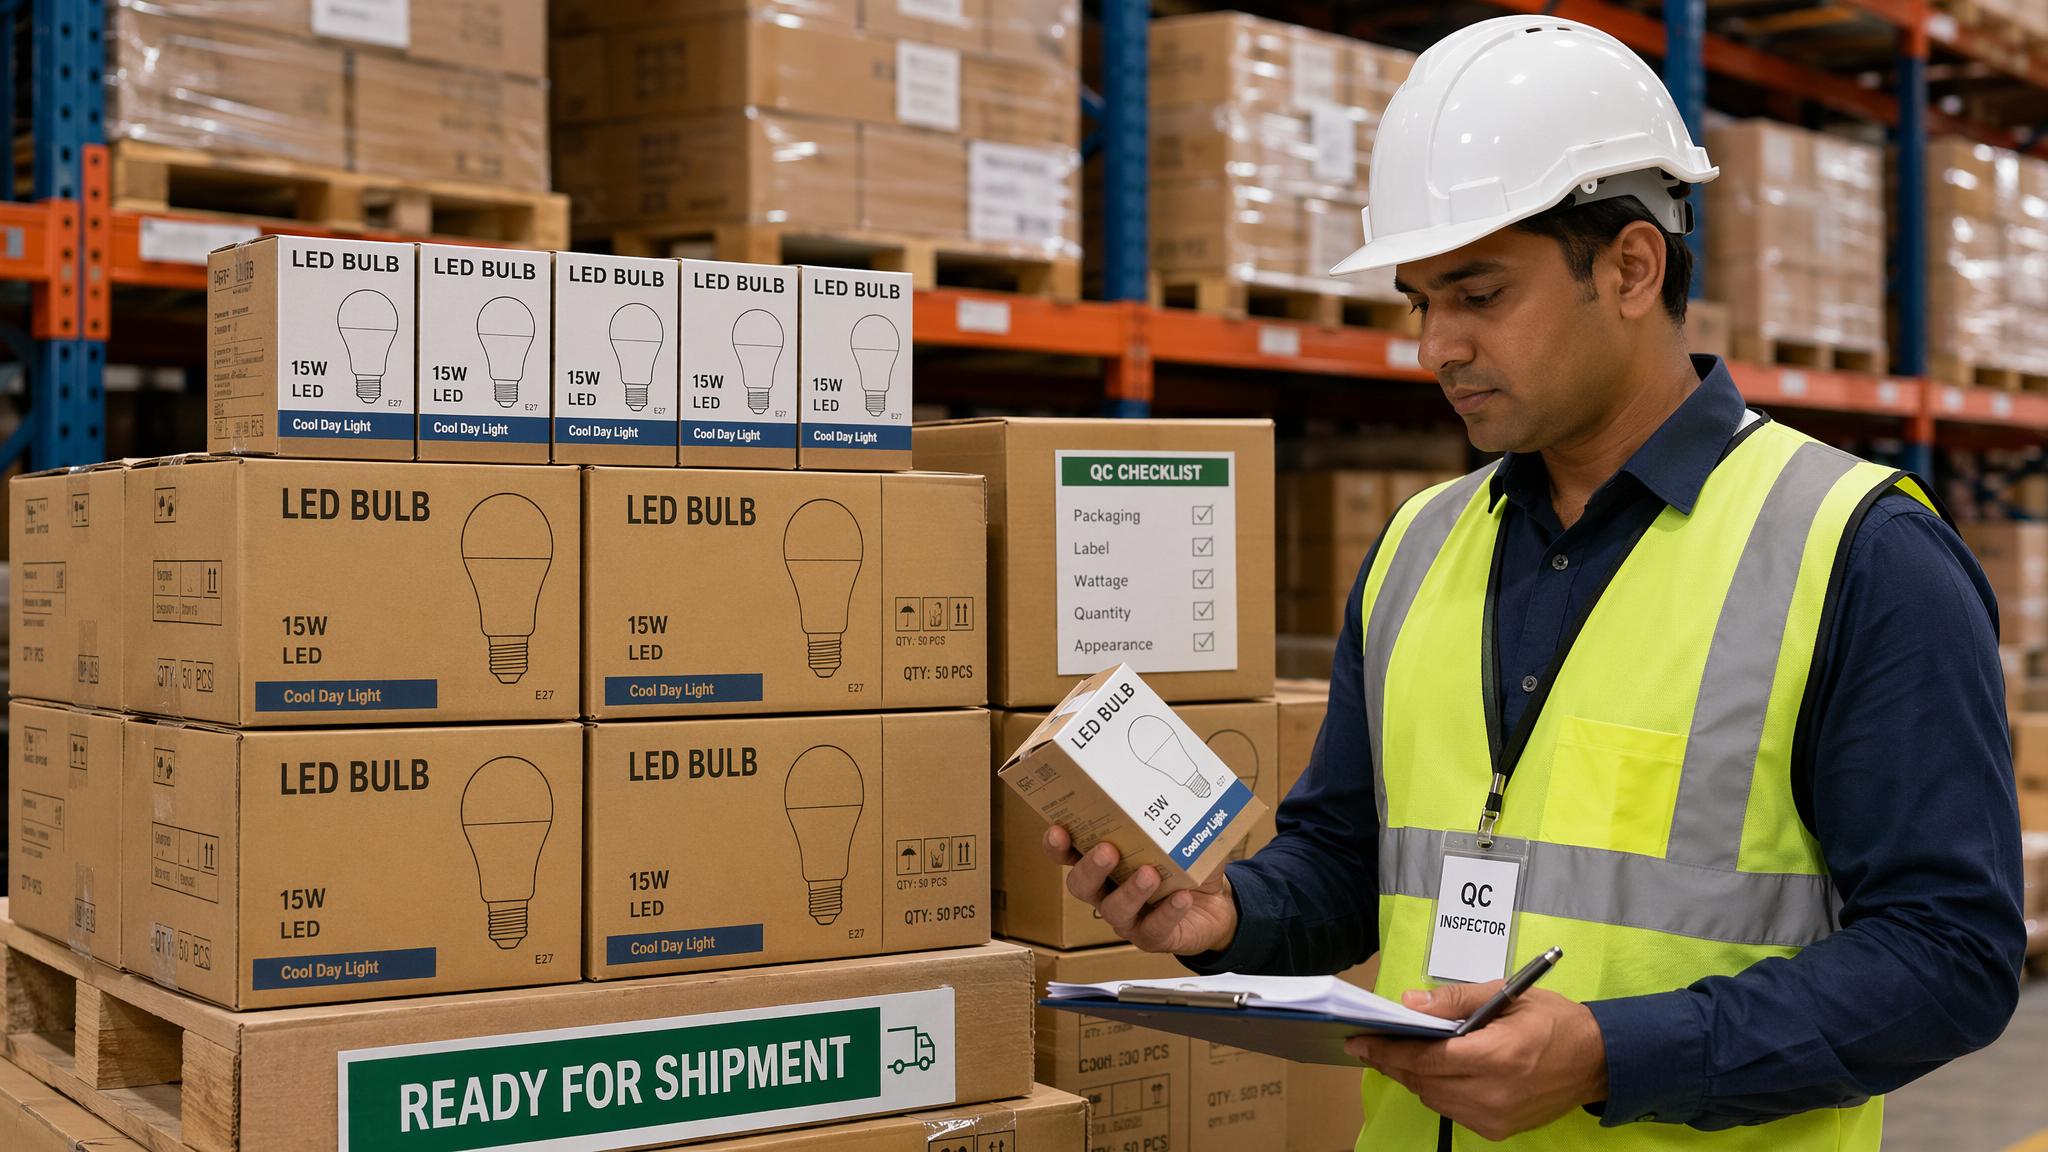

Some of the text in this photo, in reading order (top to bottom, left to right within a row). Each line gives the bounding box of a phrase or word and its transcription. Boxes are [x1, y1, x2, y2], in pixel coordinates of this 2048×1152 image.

[293, 250, 399, 272] LED BULB
[434, 258, 536, 280] LED BULB
[569, 265, 665, 287] LED BULB
[694, 272, 785, 294] LED BULB
[814, 279, 900, 299] LED BULB
[291, 361, 327, 376] 15W
[433, 366, 467, 381] 15W
[568, 371, 600, 385] 15W
[693, 374, 724, 389] 15W
[813, 378, 843, 392] 15W
[293, 384, 323, 398] LED
[434, 389, 463, 402] LED
[568, 393, 596, 406] LED
[693, 396, 720, 409] LED
[813, 399, 839, 412] LED
[654, 407, 666, 415] E27
[293, 418, 371, 434] Cool Day Light
[434, 422, 508, 436] Cool Day Light
[569, 426, 638, 439] Cool Day Light
[694, 428, 760, 442] Cool Day Light
[814, 431, 877, 444] Cool Day Light
[1090, 464, 1202, 481] QC CHECKLIST
[282, 488, 430, 521] LED BULB
[628, 495, 756, 526] LED BULB
[1074, 509, 1141, 525] Packaging
[1074, 542, 1109, 555] Label
[1074, 574, 1129, 589] Wattage
[1074, 607, 1131, 622] Quantity
[282, 616, 327, 635] 15W
[628, 616, 668, 635] 15W
[930, 636, 945, 645] PCS
[1074, 639, 1153, 654] Appearance
[283, 647, 322, 665] LED
[629, 644, 663, 660] LED
[183, 668, 191, 689] 50
[196, 669, 213, 689] PCS
[904, 665, 972, 681] QTY: 50 PCS
[536, 690, 554, 700] E27
[630, 683, 714, 699] Cool Day Light
[848, 683, 863, 692] E27
[284, 688, 381, 704] Cool Day Light
[1071, 682, 1135, 749] LED BULB
[629, 747, 757, 781] LED BULB
[281, 759, 429, 795] LED BULB
[1144, 794, 1169, 822] 15W
[1159, 813, 1181, 836] LED
[1182, 809, 1228, 857] Cool Day Light
[629, 870, 669, 891] 15W
[897, 880, 916, 890] QTY:
[931, 877, 947, 887] PCS
[280, 888, 326, 910] 15W
[1461, 882, 1493, 908] QC
[631, 900, 664, 918] LED
[905, 905, 975, 925] QTY: 50 PCS
[281, 920, 320, 939] LED
[1440, 914, 1506, 936] INSPECTOR
[848, 929, 864, 939] E27
[631, 936, 715, 955] Cool Day Light
[536, 954, 553, 964] E27
[281, 959, 379, 981] Cool Day Light
[1144, 1044, 1169, 1062] PCS
[401, 1034, 851, 1133] READY FOR SHIPMENT
